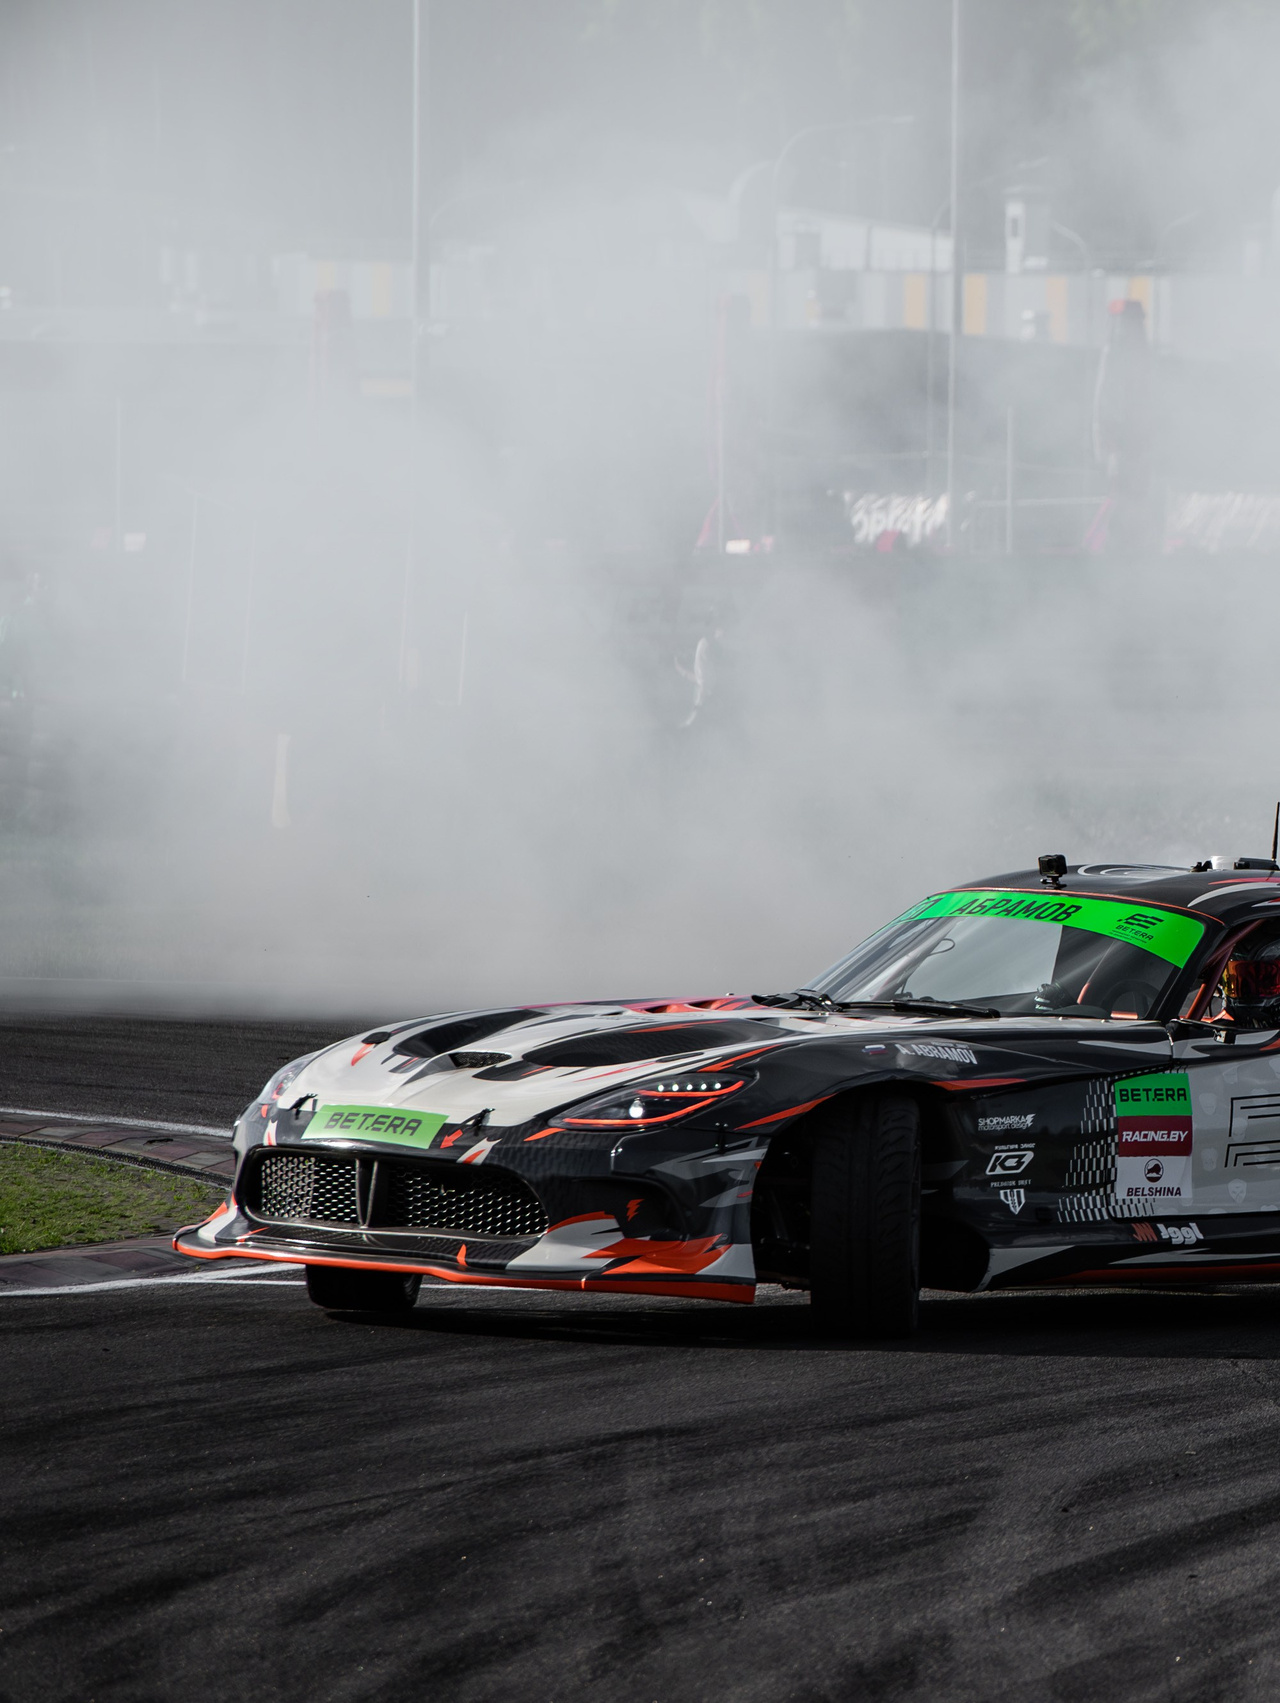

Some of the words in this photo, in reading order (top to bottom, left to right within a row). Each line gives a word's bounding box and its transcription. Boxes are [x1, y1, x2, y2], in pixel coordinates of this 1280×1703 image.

[949, 898, 1083, 922] АБРАМОВ
[978, 1115, 1027, 1126] SHOPMARKA
[1122, 1130, 1188, 1142] RACING.BY
[1126, 1186, 1182, 1197] BELSHINA
